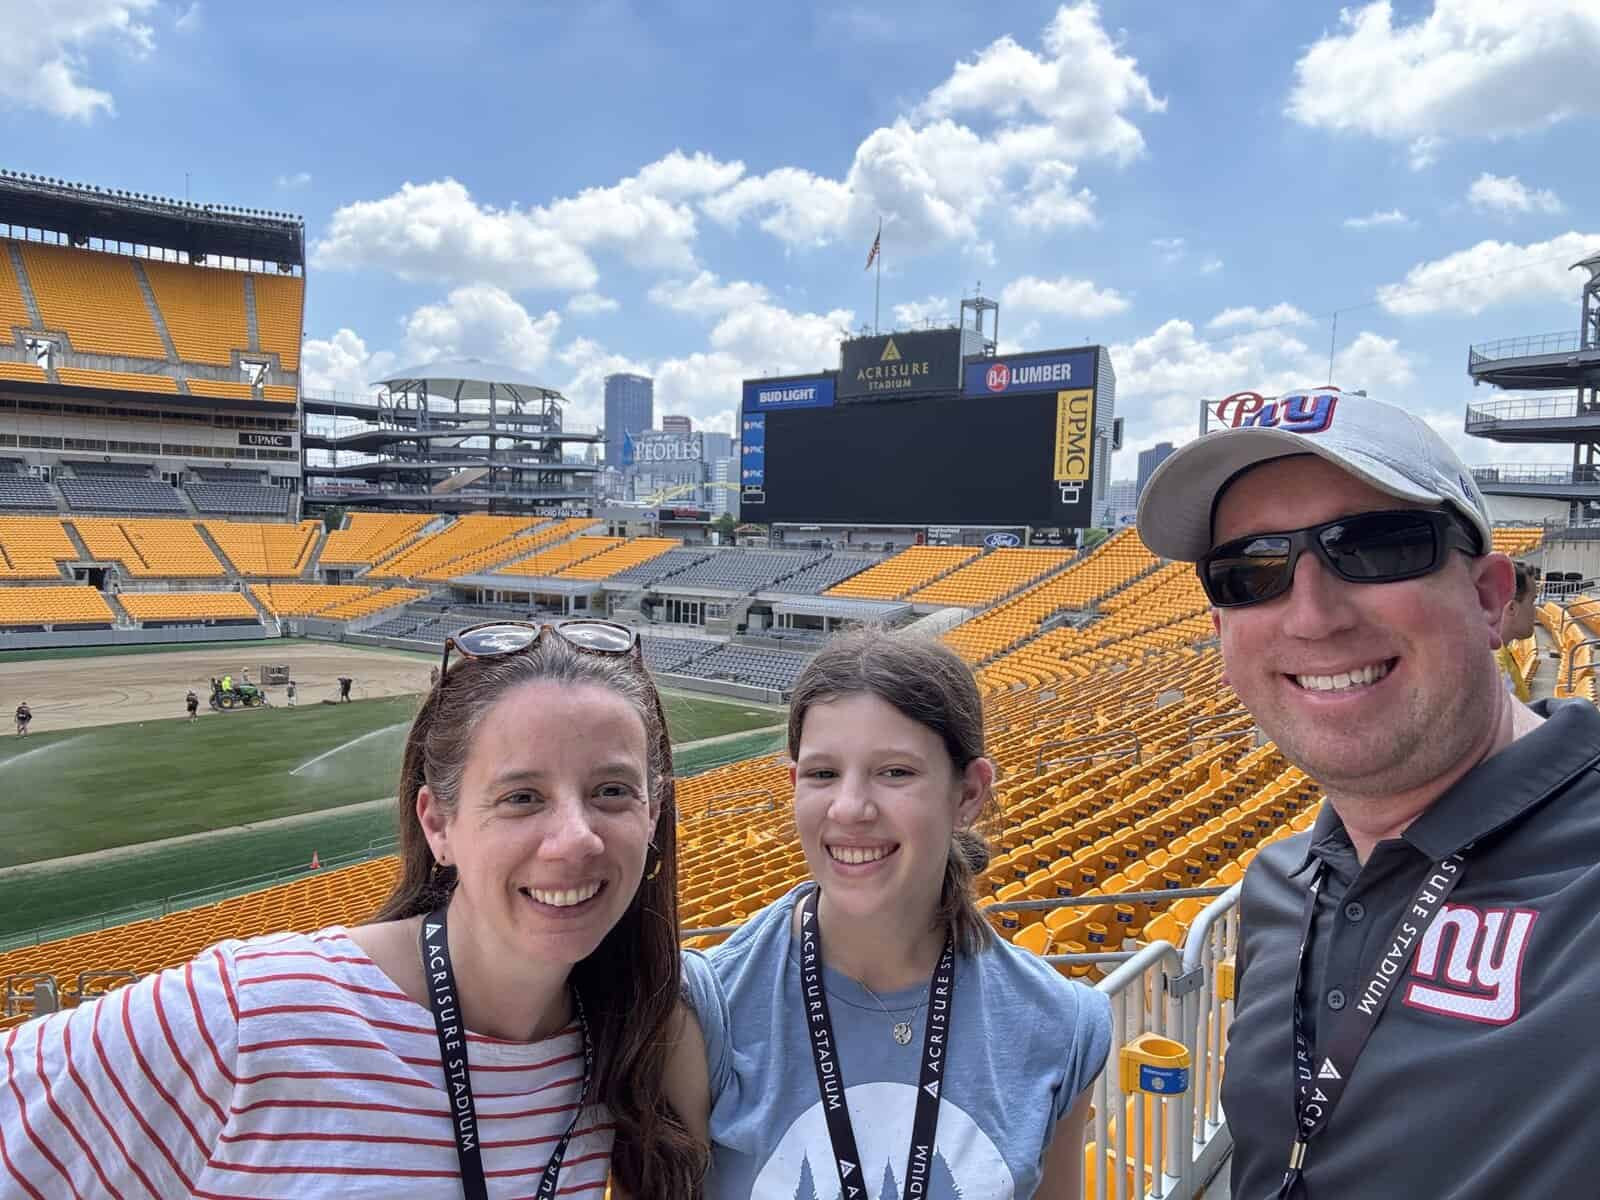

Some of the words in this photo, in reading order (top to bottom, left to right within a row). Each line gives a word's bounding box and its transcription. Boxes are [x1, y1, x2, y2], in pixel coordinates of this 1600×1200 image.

[856, 361, 929, 381] ACRISURE
[988, 370, 1009, 387] 84
[1011, 363, 1072, 385] LUMBER
[759, 391, 782, 403] BUD
[782, 388, 817, 401] LIGHT
[868, 378, 911, 391] STADIUM
[248, 434, 284, 446] UPMC
[1066, 394, 1089, 475] UPMC
[635, 440, 701, 461] PEOPLES
[1357, 922, 1418, 1016] STADIUM
[803, 931, 824, 1023] ACRISURE
[815, 1029, 842, 1111] STADIUM
[927, 976, 949, 1073] ACRISURE
[428, 944, 461, 1051] ACRISURE
[449, 1058, 475, 1152] STADIUM
